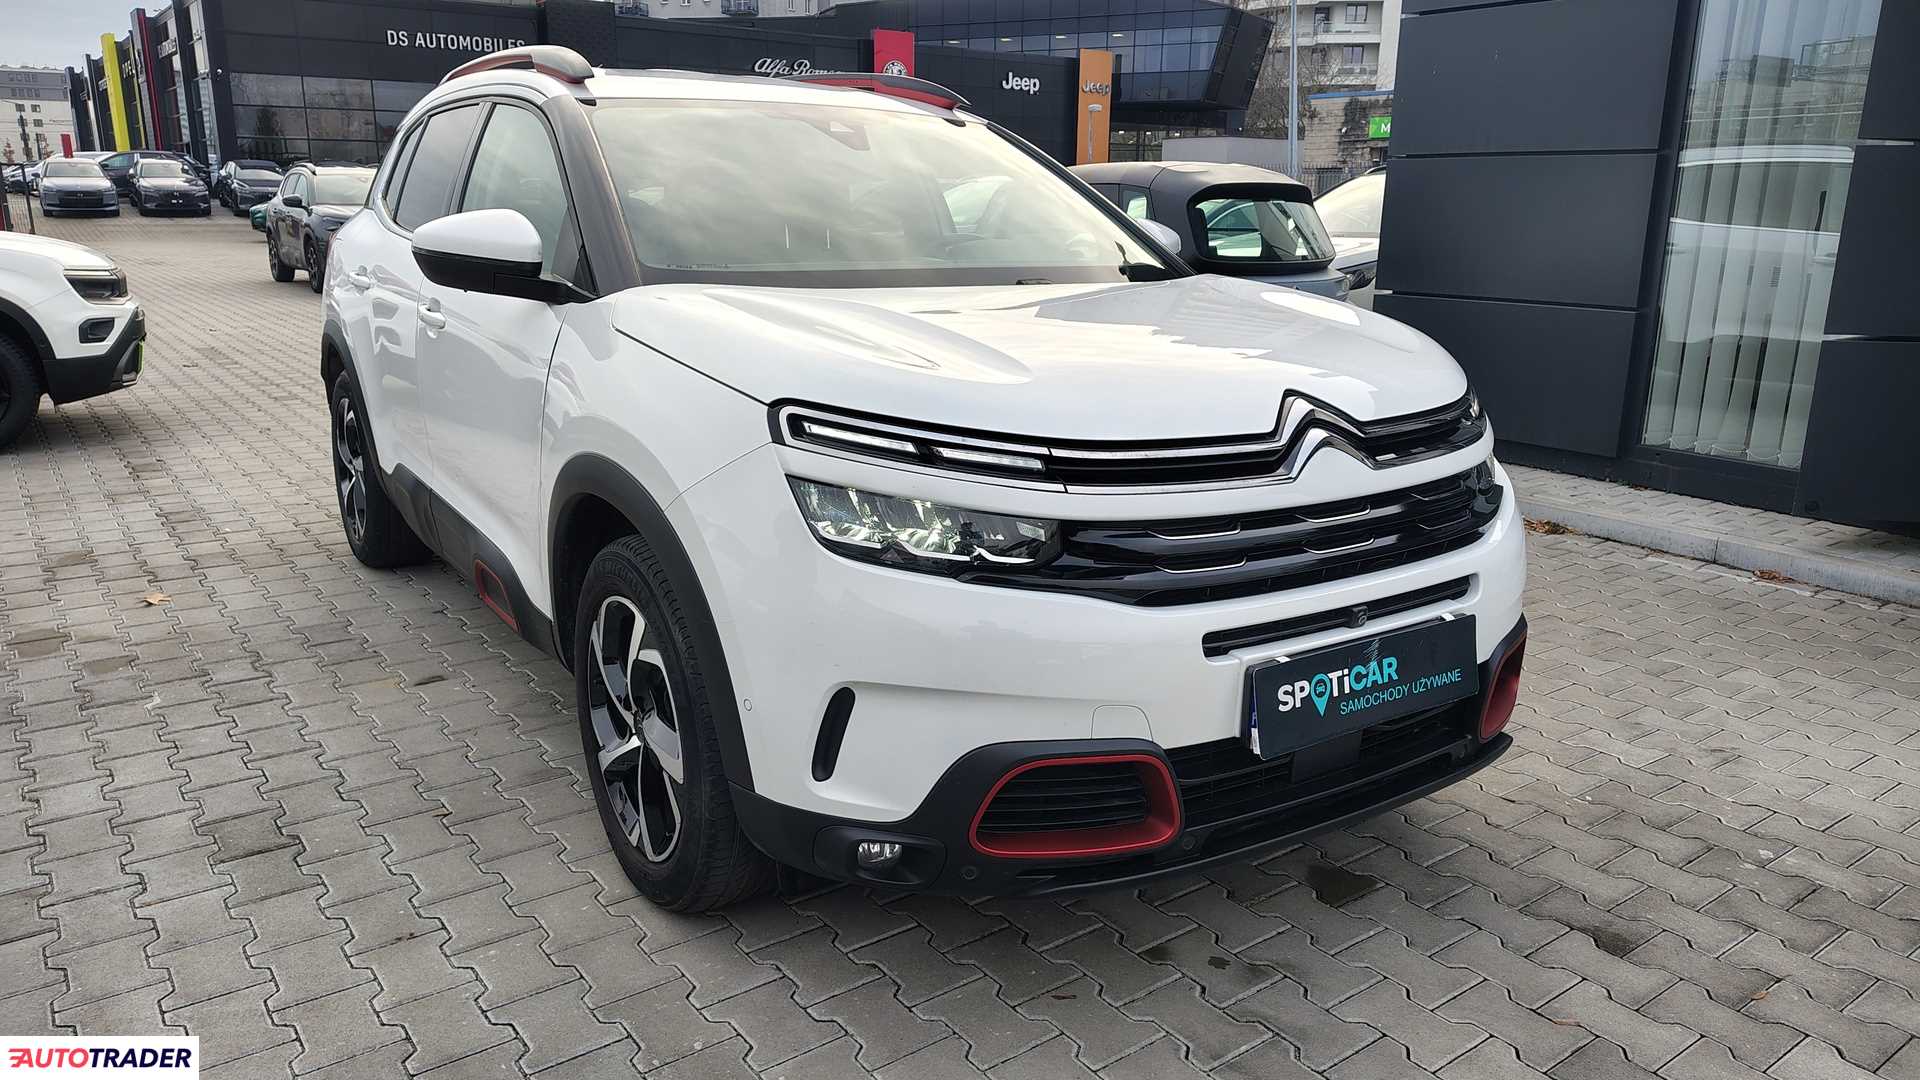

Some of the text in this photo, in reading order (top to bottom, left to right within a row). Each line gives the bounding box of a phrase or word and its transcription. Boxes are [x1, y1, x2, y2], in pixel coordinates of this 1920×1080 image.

[387, 30, 409, 46] DS
[754, 57, 792, 78] Alfa
[1002, 71, 1040, 95] Jeep
[1081, 80, 1110, 96] Jeep
[1340, 668, 1462, 715] SAMOCHODY UŻYWANE
